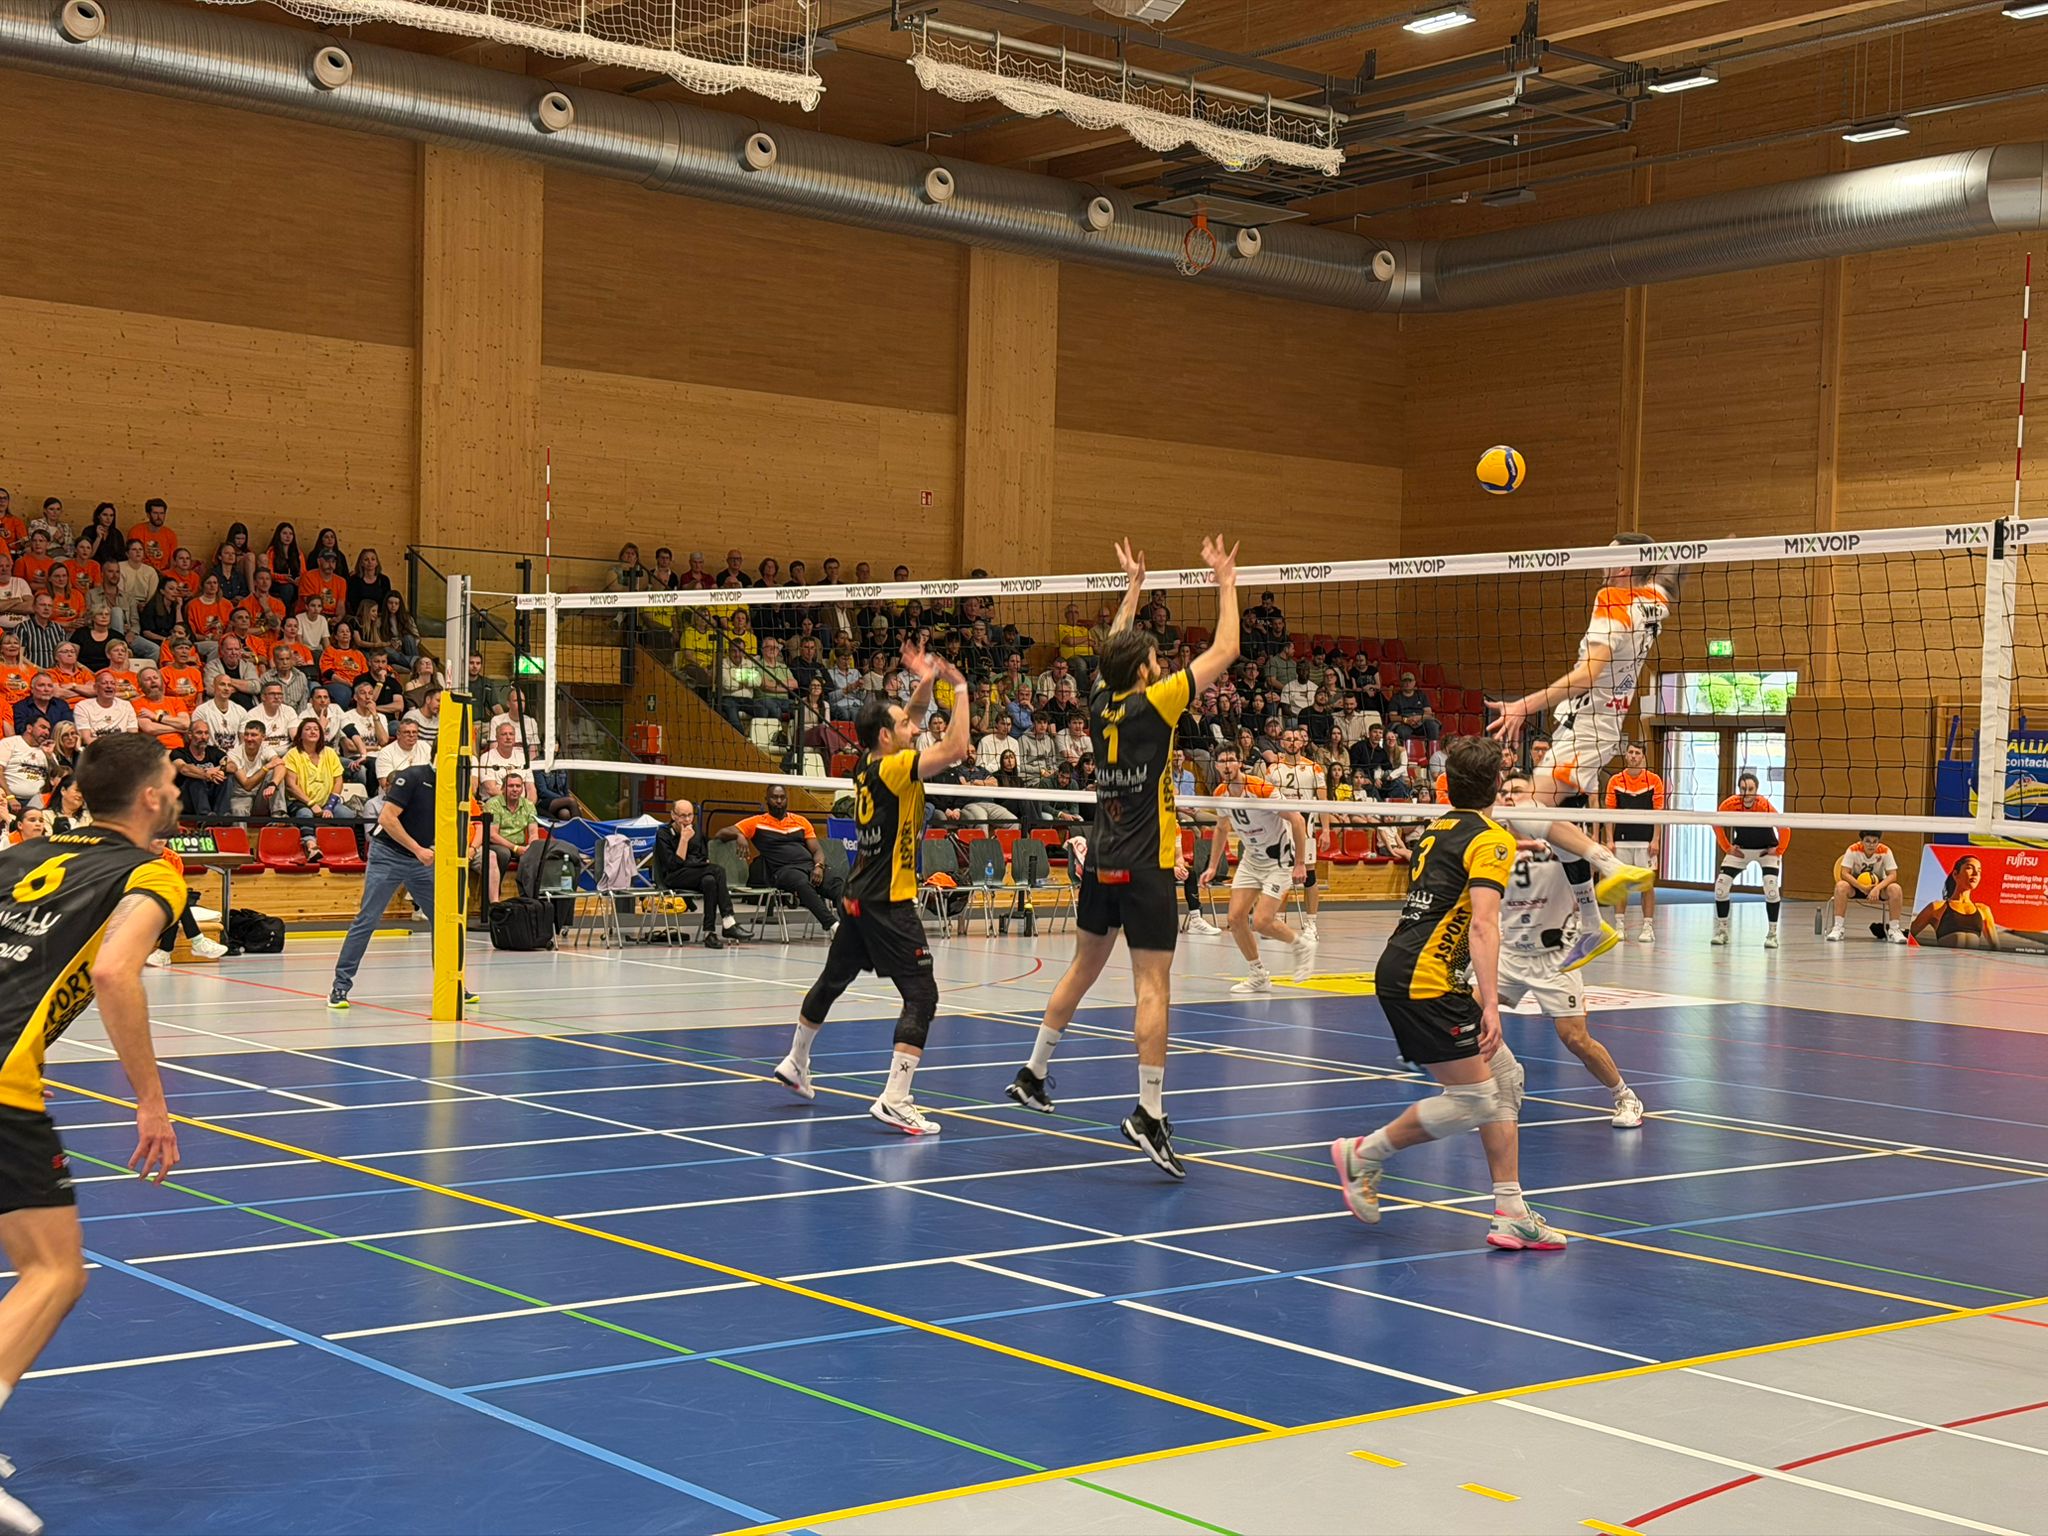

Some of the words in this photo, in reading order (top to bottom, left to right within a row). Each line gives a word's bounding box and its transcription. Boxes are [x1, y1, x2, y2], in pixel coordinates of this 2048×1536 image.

[1785, 534, 1860, 554] MIXVOIP
[1639, 543, 1708, 562] MIXVOIP
[1389, 559, 1446, 575] MIXVOIP
[1508, 552, 1571, 569] MIXVOIP
[1279, 565, 1332, 580] MIXVOIP
[845, 586, 882, 598] MIXVOIP
[920, 583, 959, 595] MIXVOIP
[1000, 579, 1042, 592] MIXVOIP
[589, 595, 619, 605] MIXVOIP
[648, 593, 679, 604] MIXVOIP
[709, 591, 742, 602] MIXVOIP
[775, 589, 810, 600] MIXVOIP
[1102, 724, 1118, 764] 1
[1286, 773, 1295, 789] 2
[169, 837, 185, 851] 12
[1411, 836, 1436, 882] 3
[2006, 851, 2038, 868] FUJITSU
[11, 852, 81, 903] 6
[1515, 860, 1531, 888] 9
[1568, 995, 1577, 1008] 9
